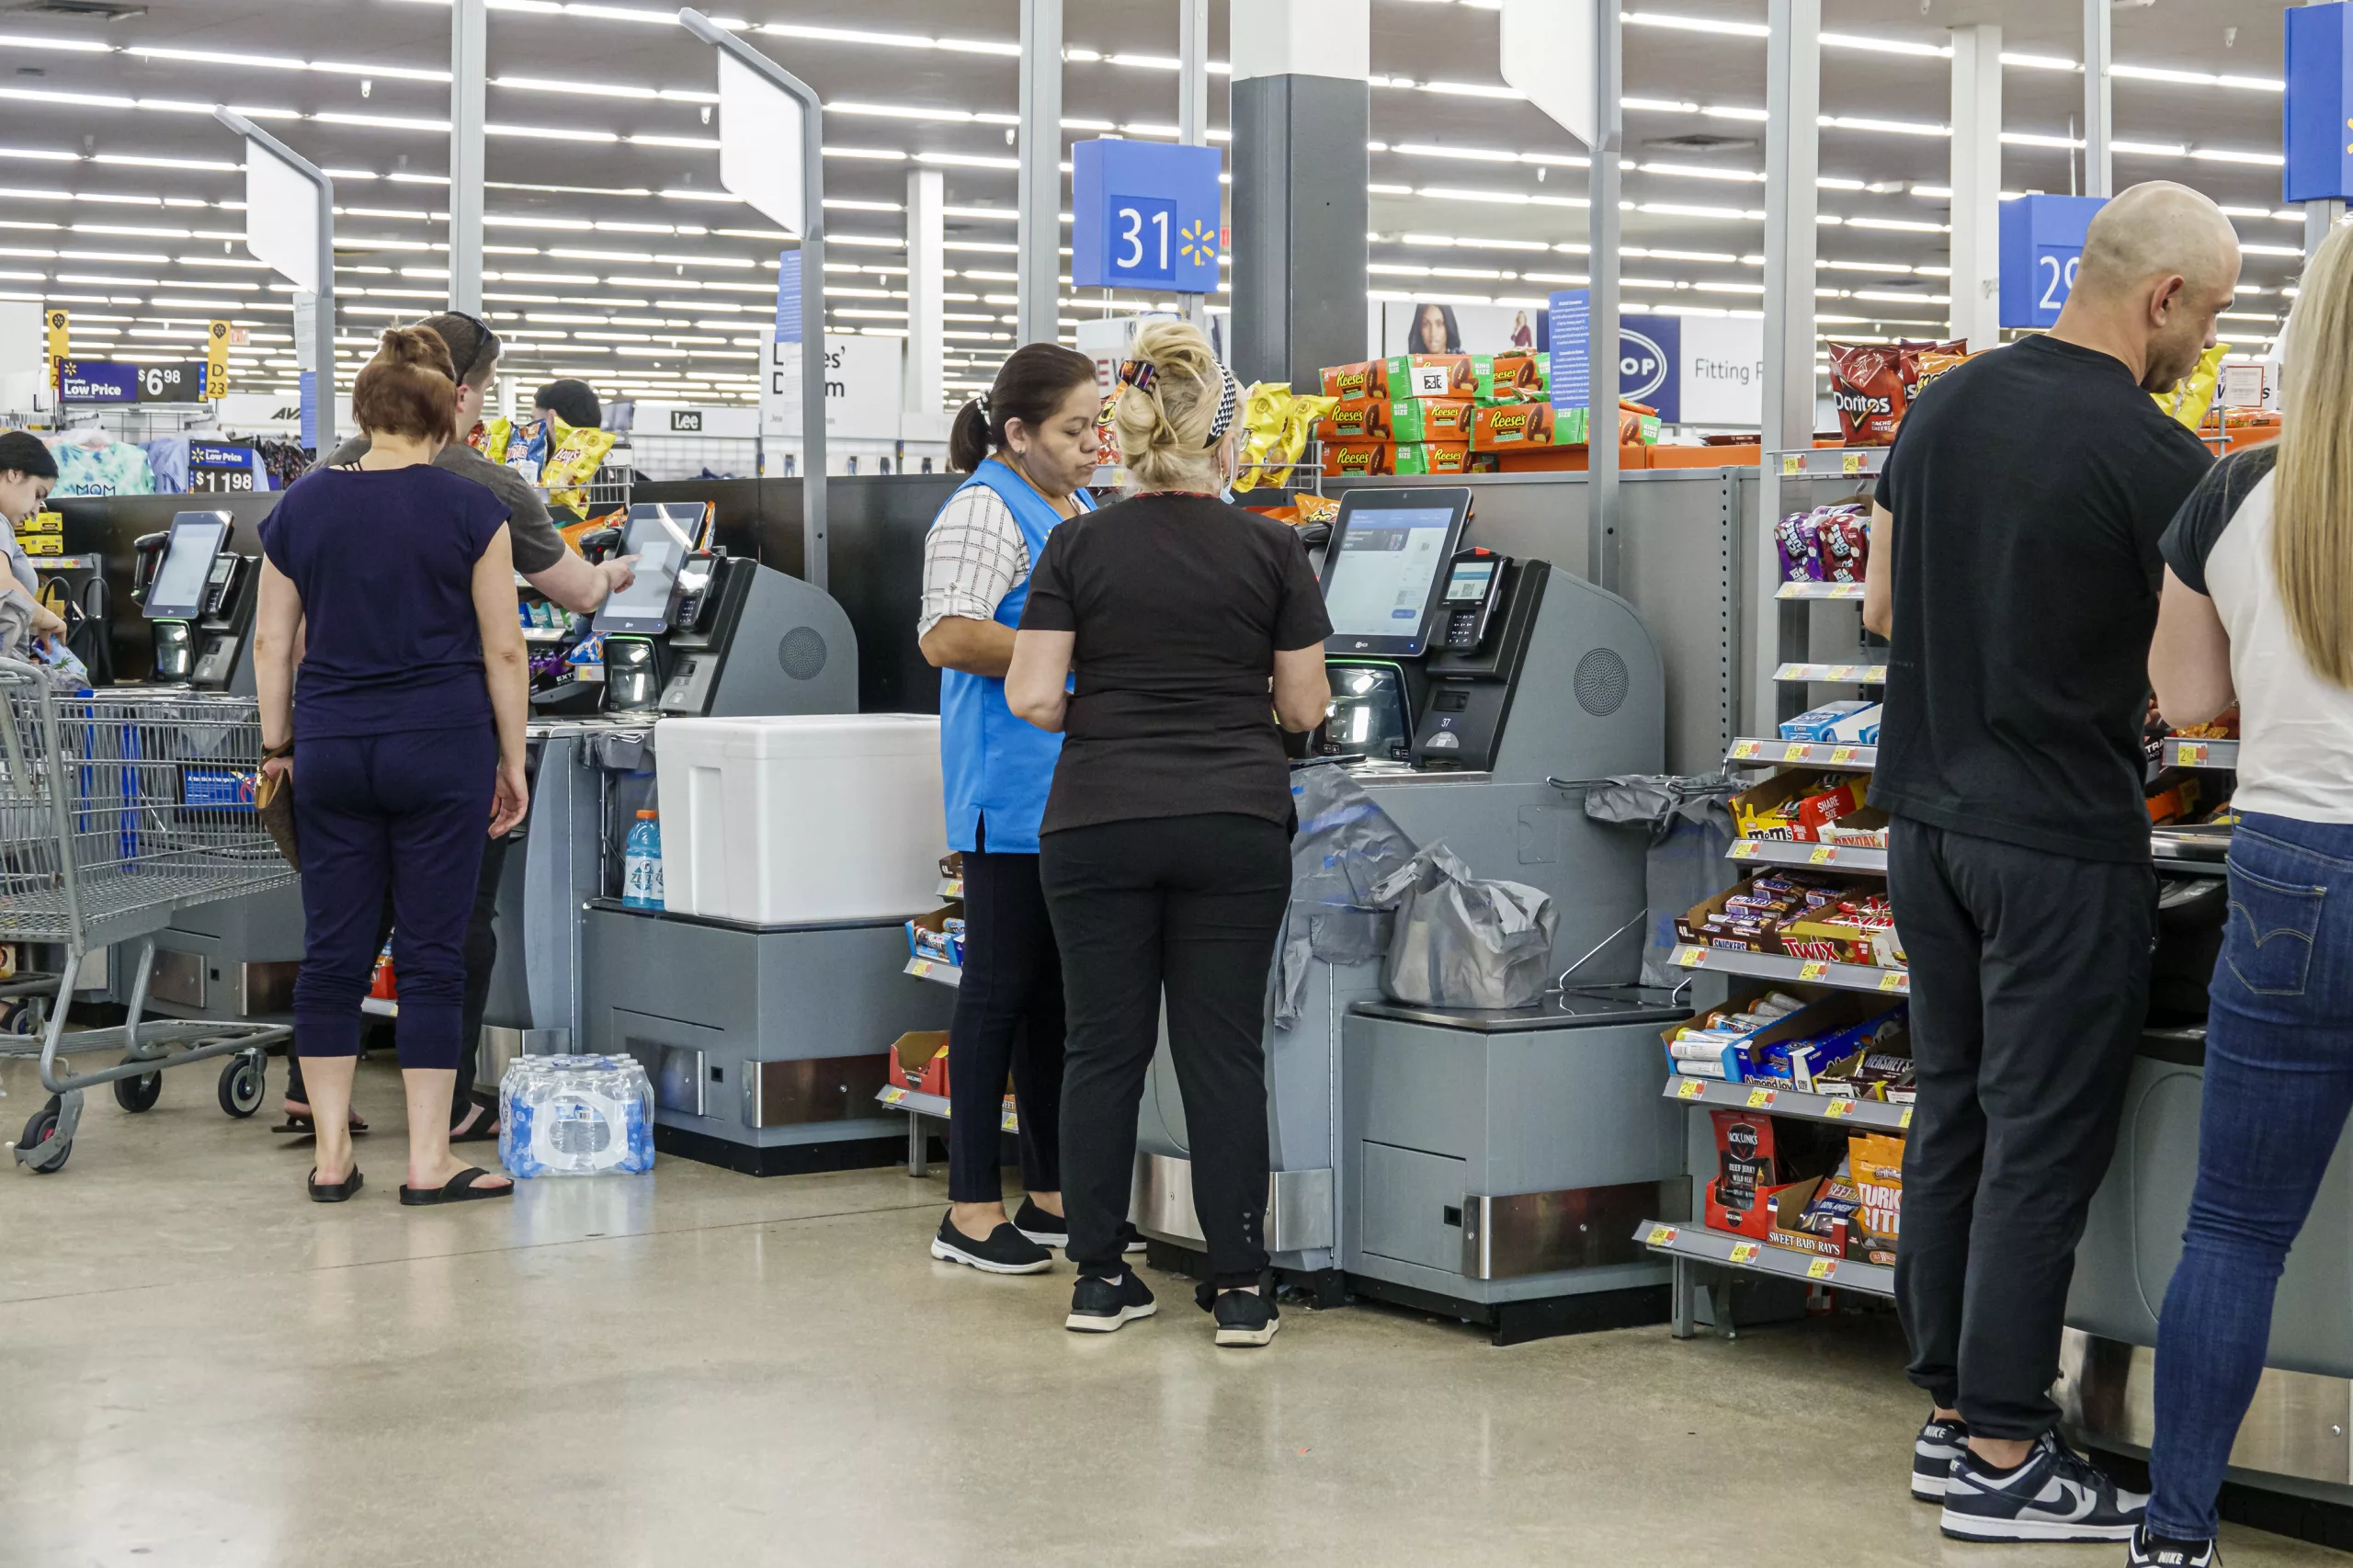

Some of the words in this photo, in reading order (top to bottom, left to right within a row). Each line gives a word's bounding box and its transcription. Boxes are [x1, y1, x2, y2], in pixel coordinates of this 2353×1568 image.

[1117, 208, 1167, 270] 31
[212, 364, 224, 377] D
[1388, 360, 1399, 369] KING
[1336, 369, 1365, 387] Reese's
[1494, 369, 1517, 380] eese's
[1695, 358, 1750, 385] Fitting
[64, 383, 90, 395] Low
[91, 383, 121, 395] Price
[209, 382, 225, 395] 23
[1833, 392, 1891, 413] Doritos
[1332, 404, 1363, 421] Reese's
[1431, 404, 1459, 416] Reese's
[1557, 410, 1572, 418] SIZE
[675, 413, 699, 429] Lee
[1490, 410, 1526, 428] Reese's
[1643, 423, 1658, 432] KING
[1643, 429, 1658, 438] SIZE
[206, 452, 222, 461] Low
[222, 452, 242, 462] Price
[1337, 448, 1370, 464] Reese's
[1434, 449, 1461, 460] Reese's
[76, 483, 116, 496] MOM
[1441, 718, 1451, 727] 37
[1817, 795, 1839, 813] SHARE
[1824, 808, 1837, 821] SIZE
[1793, 824, 1807, 834] SHARE
[1797, 831, 1806, 840] SIZE
[1678, 926, 1688, 937] 48
[1713, 938, 1745, 951] SNICKERS
[1802, 964, 1816, 975] 212
[1864, 1053, 1914, 1073] HERSHEY'S
[1680, 1082, 1694, 1094] 212
[1745, 1074, 1778, 1089] Almond
[1750, 1092, 1764, 1103] 212
[1742, 1165, 1756, 1174] JERKY
[1733, 1174, 1744, 1182] WILD
[1768, 1231, 1795, 1246] SWEET
[1796, 1237, 1816, 1250] BABY
[1818, 1242, 1840, 1256] RAY'S
[1924, 1425, 1946, 1439] NIKE
[2158, 1551, 2184, 1565] NIKE
